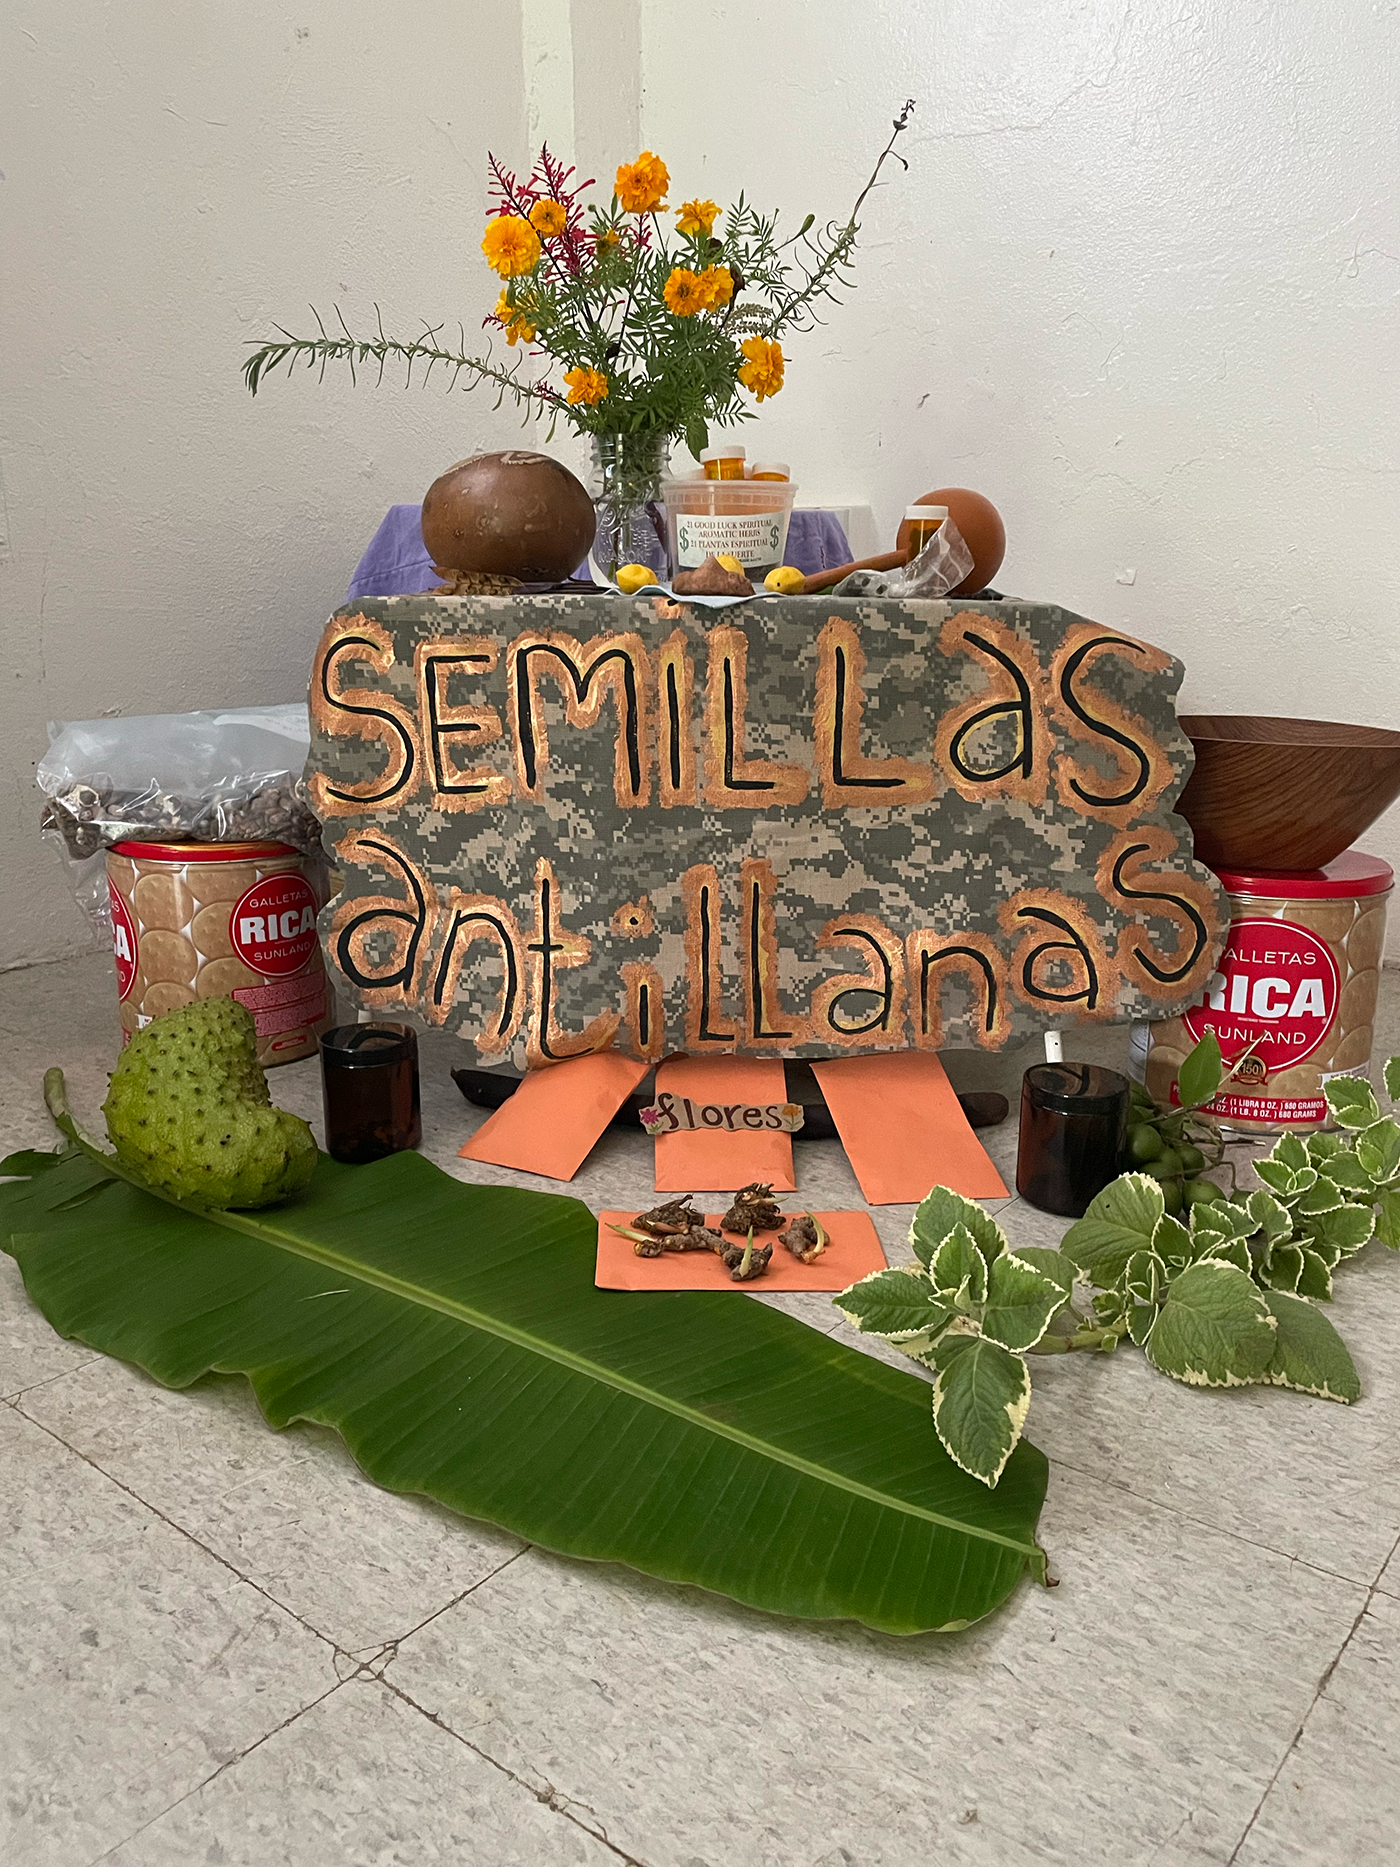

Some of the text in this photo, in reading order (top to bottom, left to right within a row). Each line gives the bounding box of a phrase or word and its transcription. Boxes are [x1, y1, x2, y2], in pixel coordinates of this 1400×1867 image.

[694, 520, 716, 529] GOOD
[717, 520, 738, 529] LUCK
[739, 519, 773, 529] SPIRITUAL
[698, 529, 761, 539] AROMATIC HERBS
[698, 540, 730, 549] PLANTAS
[731, 538, 768, 549] ESPIRITUAL
[249, 888, 308, 909] GALLETAS
[239, 905, 317, 945] RICA
[253, 941, 311, 962] SUNLAND
[1224, 947, 1317, 966] ALLETAS
[1195, 971, 1326, 1018] RICA
[1203, 1023, 1307, 1045] SUNLAND
[1241, 1062, 1259, 1075] 150
[657, 1092, 783, 1130] flores
[1239, 1098, 1259, 1109] LIBRA
[1298, 1100, 1324, 1110] GRAMOS
[1292, 1110, 1317, 1119] GRAMS
